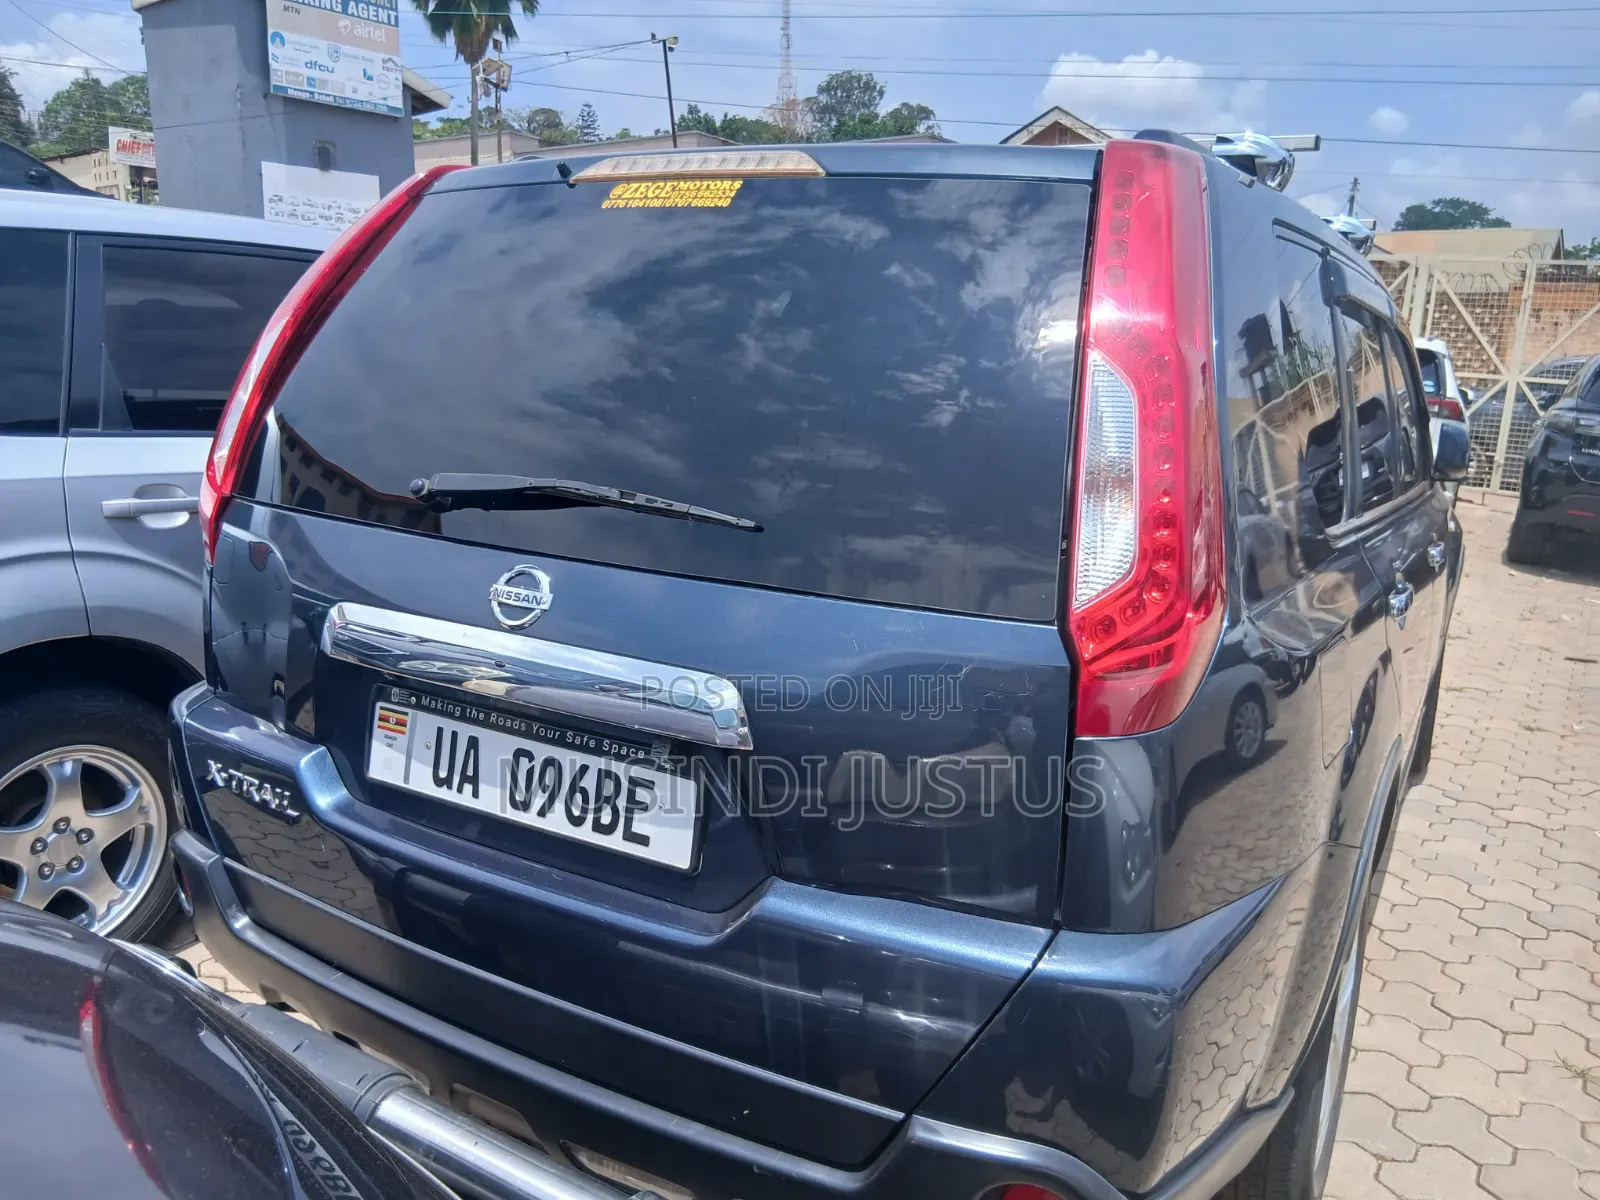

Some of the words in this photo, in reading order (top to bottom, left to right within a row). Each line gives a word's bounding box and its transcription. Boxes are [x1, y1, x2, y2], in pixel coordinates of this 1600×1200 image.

[283, 5, 301, 15] MTN
[347, 1, 398, 25] AGENT
[353, 22, 387, 43] airtel
[304, 60, 335, 74] dfcu
[116, 138, 142, 155] CHIEF
[609, 182, 678, 199] @ZEGE
[676, 180, 743, 190] MOTORS
[494, 587, 543, 606] NISSAN
[421, 696, 461, 717] Making
[466, 707, 485, 720] the
[490, 713, 526, 731] Roads
[532, 723, 560, 740] Your
[566, 732, 596, 748] Safe
[602, 740, 645, 758] Space
[205, 759, 300, 818] X-TRAIL
[432, 726, 479, 799] UA
[509, 747, 656, 847] 096BE
